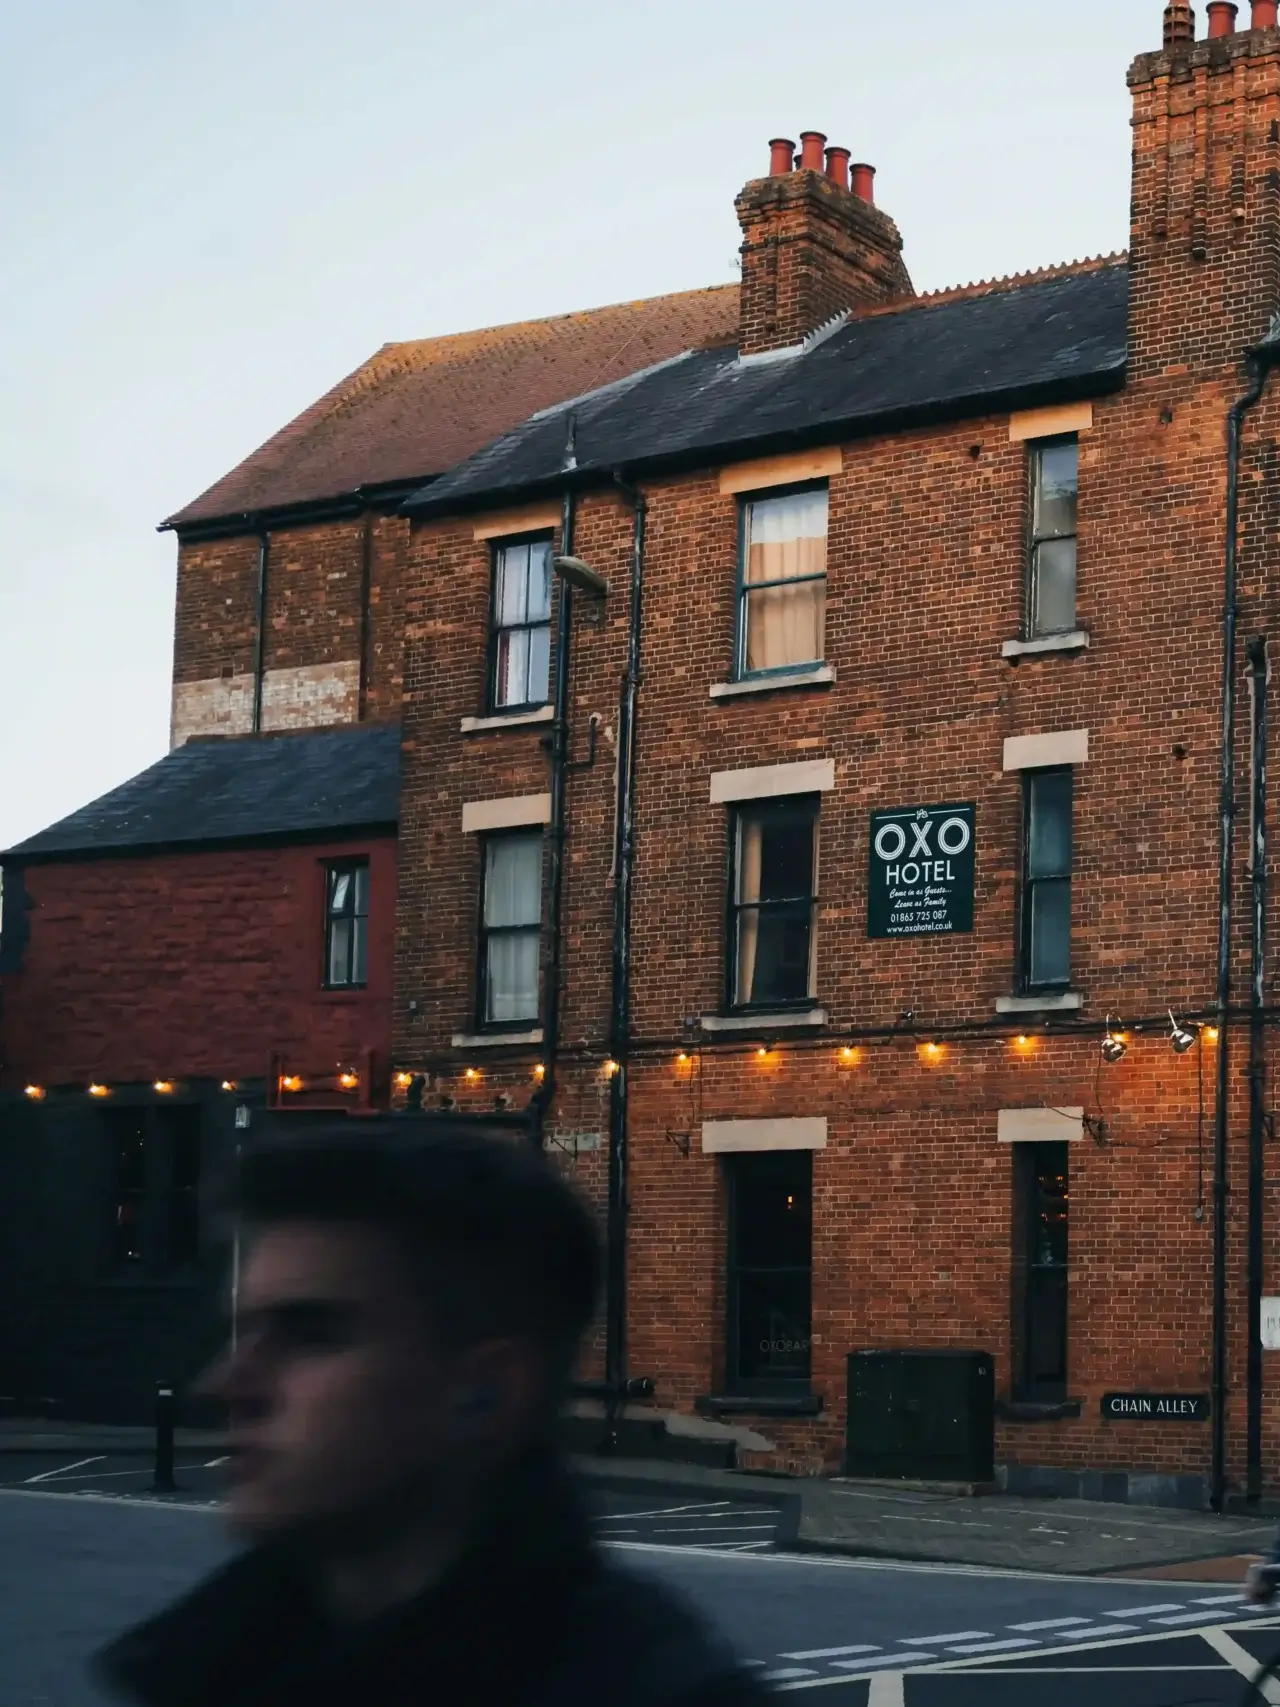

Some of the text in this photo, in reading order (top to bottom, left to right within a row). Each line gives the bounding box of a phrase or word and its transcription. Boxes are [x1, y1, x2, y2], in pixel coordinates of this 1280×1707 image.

[875, 817, 970, 860] OXO
[886, 860, 955, 886] HOTEL
[890, 888, 906, 898] Come
[908, 888, 914, 896] in
[894, 899, 914, 908] Leave
[923, 898, 946, 908] Family
[891, 910, 947, 922] 01865 725 087
[887, 921, 952, 933] www.oxohotel.co.uk
[1110, 1398, 1198, 1414] CHAIN ALLEY
